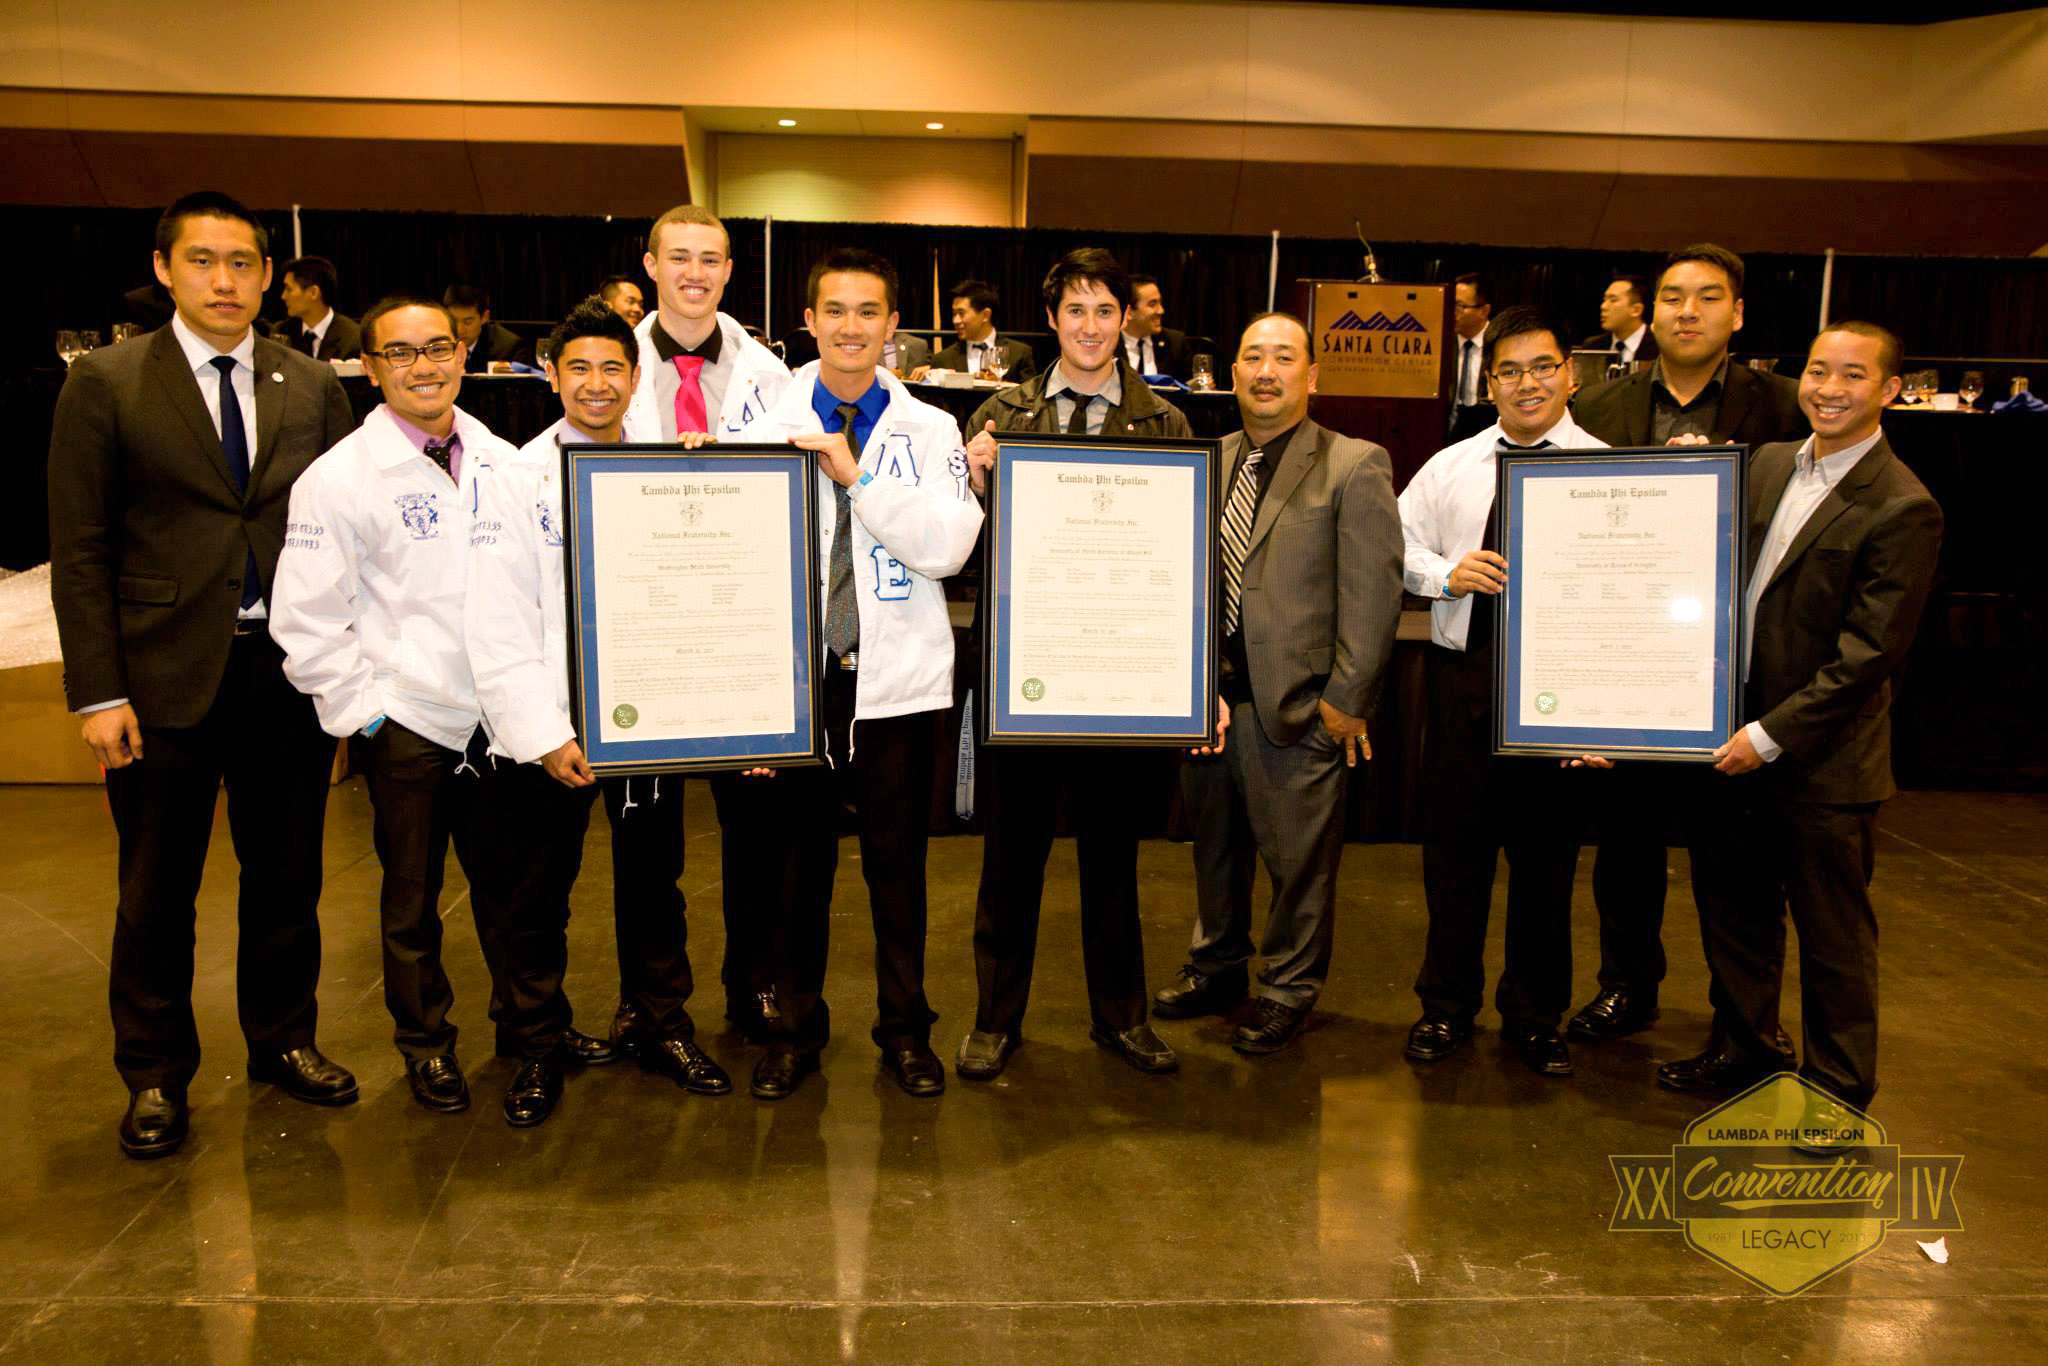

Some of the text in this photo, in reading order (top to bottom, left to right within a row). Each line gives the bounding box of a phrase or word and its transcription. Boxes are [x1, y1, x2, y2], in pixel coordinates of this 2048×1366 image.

[1323, 333, 1432, 355] SANTA CLARA
[1057, 473, 1149, 487] Lambda Phi Epsilon
[641, 483, 741, 497] Lambda Phi Epsilon
[1569, 487, 1667, 500] Lambda Phi Epsilon
